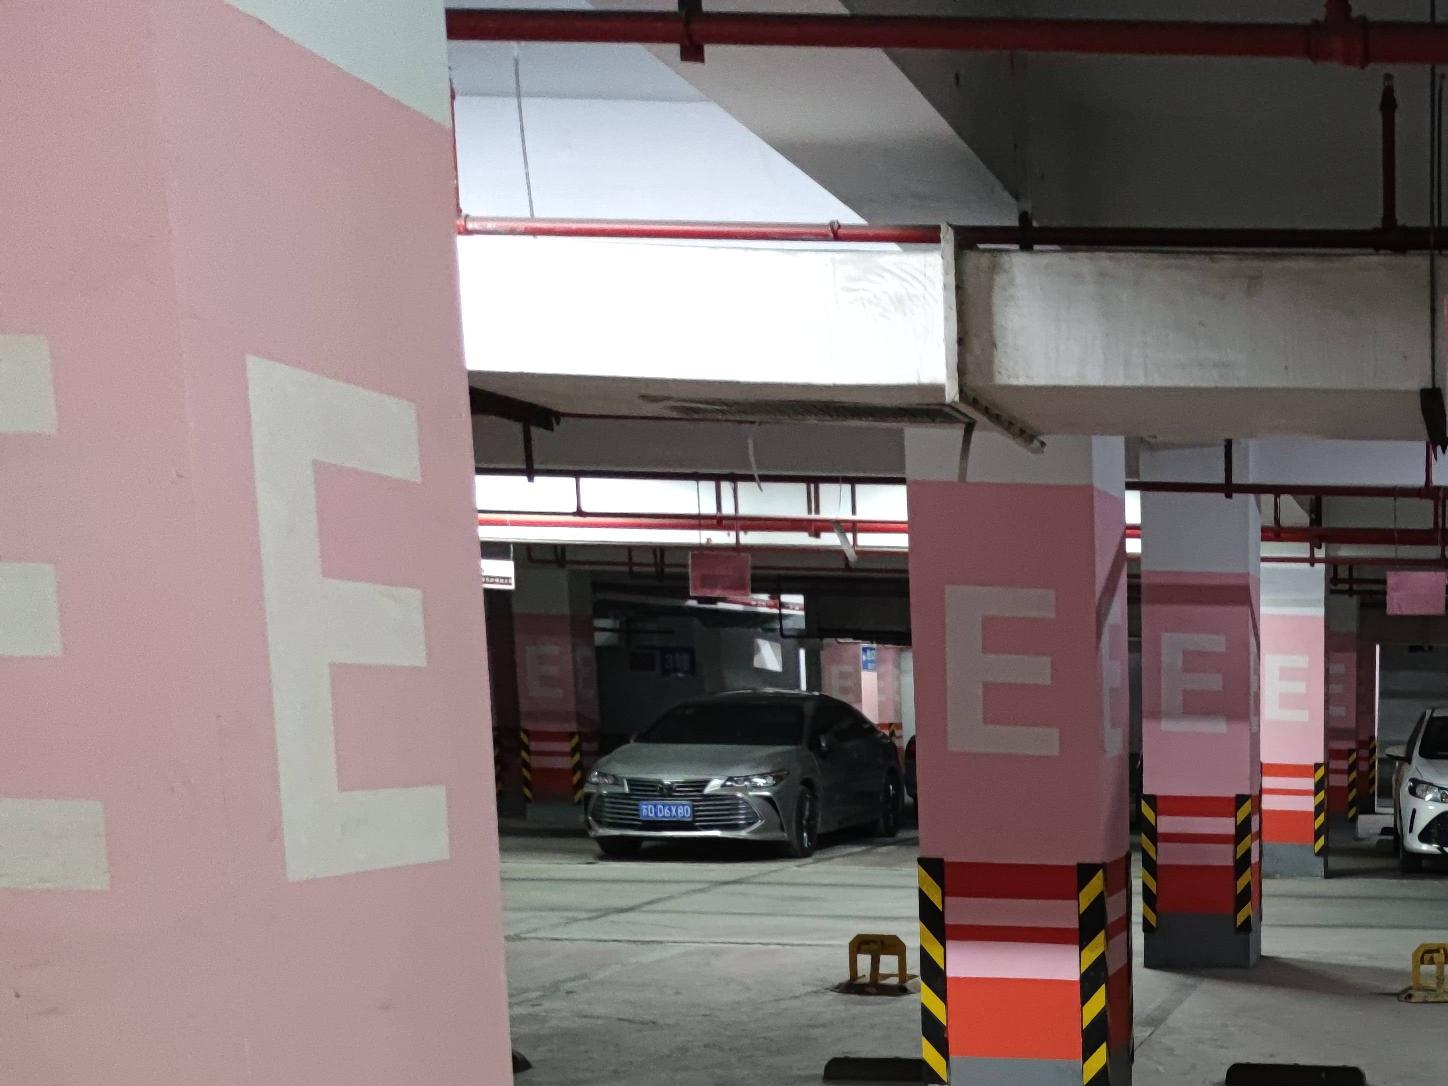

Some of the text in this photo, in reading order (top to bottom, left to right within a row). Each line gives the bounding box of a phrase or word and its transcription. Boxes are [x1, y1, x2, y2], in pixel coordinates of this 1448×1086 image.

[246, 354, 450, 882] E
[945, 584, 1060, 757] E
[1160, 632, 1227, 734] E
[1264, 654, 1309, 722] E
